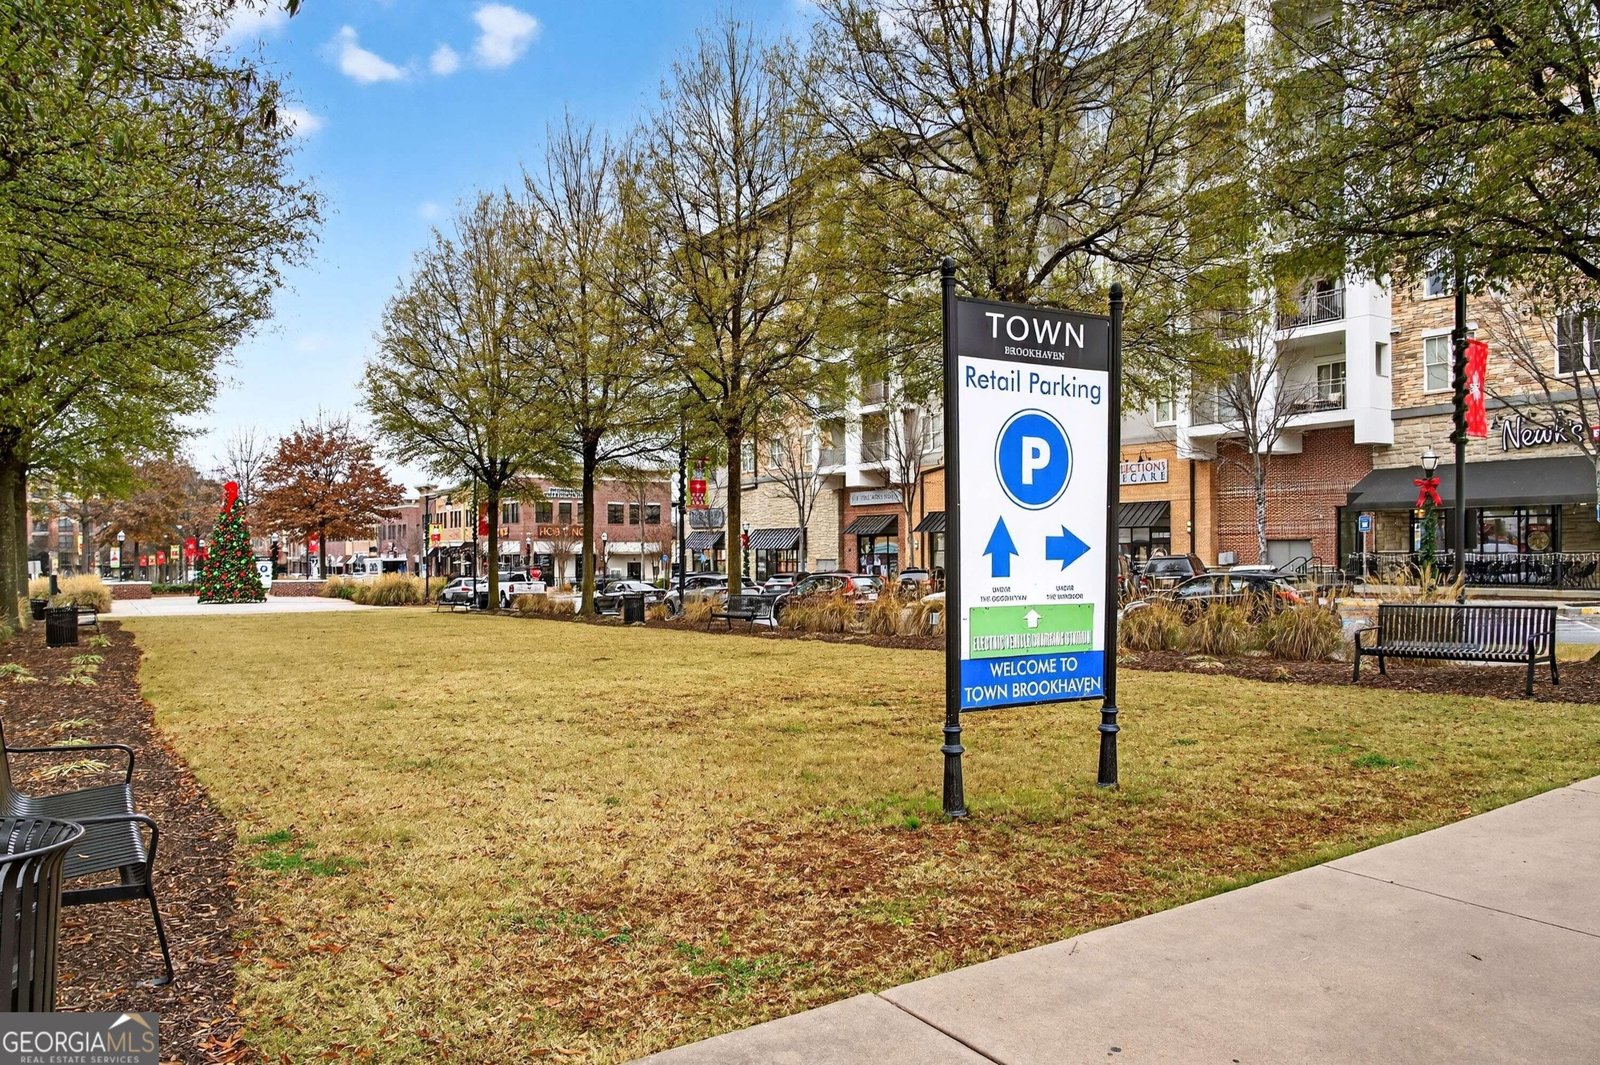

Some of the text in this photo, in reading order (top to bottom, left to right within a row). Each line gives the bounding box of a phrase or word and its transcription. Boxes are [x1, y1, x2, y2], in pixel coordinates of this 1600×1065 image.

[985, 312, 1084, 349] TOWN
[1004, 346, 1065, 361] BROOKHAVEN
[965, 365, 1101, 405] Retail Parking
[1021, 435, 1051, 486] P
[990, 657, 1078, 678] WELCOME TO
[964, 676, 1101, 702] TOWN BROOKHAVEN
